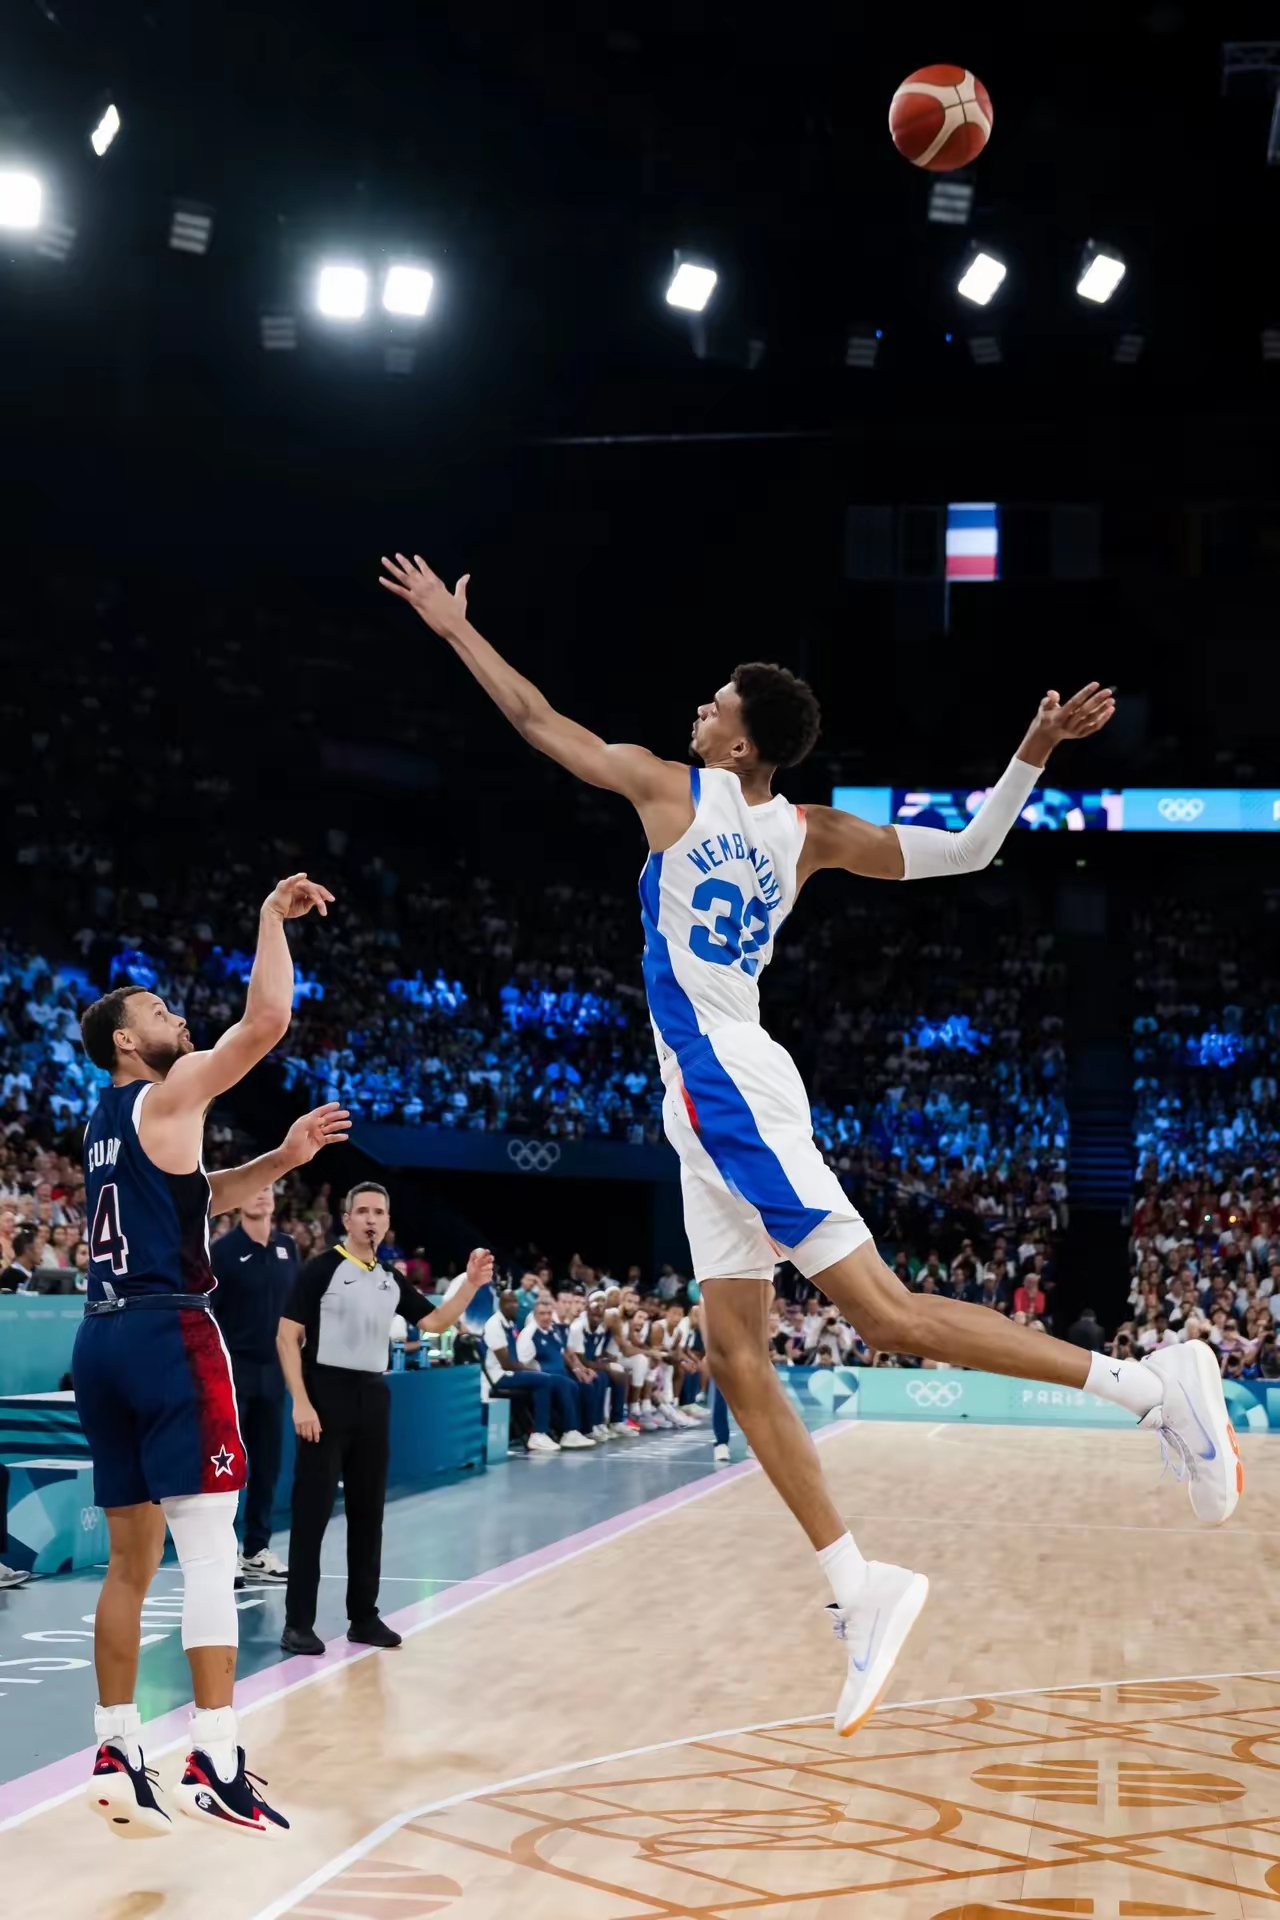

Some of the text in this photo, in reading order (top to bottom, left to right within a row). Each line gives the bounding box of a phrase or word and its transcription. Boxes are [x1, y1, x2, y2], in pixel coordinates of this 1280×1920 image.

[687, 833, 782, 911] WEMBYAMA
[689, 877, 770, 977] 32
[92, 1183, 129, 1275] 4
[1023, 1389, 1085, 1406] PARIS
